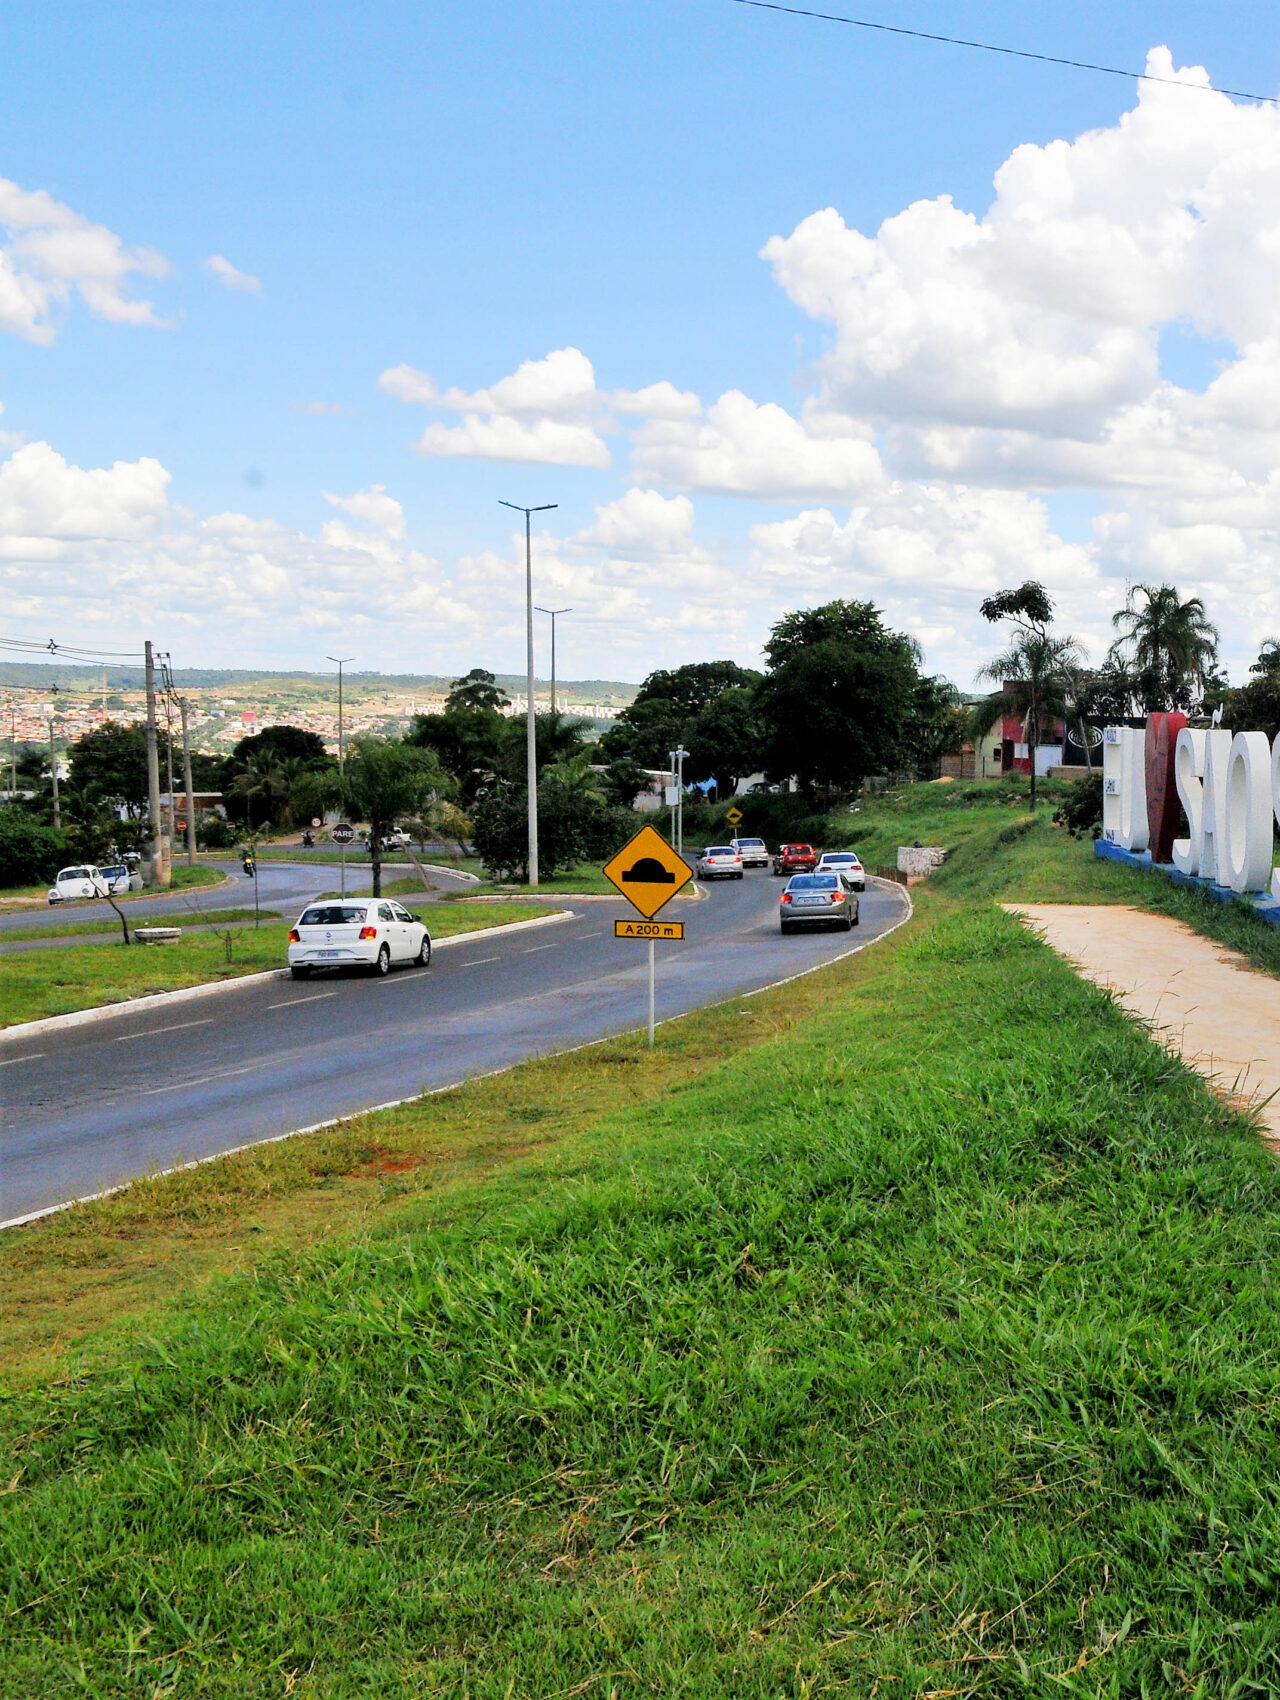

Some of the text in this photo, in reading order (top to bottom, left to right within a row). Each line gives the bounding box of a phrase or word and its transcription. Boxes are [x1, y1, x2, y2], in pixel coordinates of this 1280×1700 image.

[1173, 703, 1272, 892] SÃO
[332, 830, 354, 838] PARE
[626, 925, 674, 936] A 200 m
